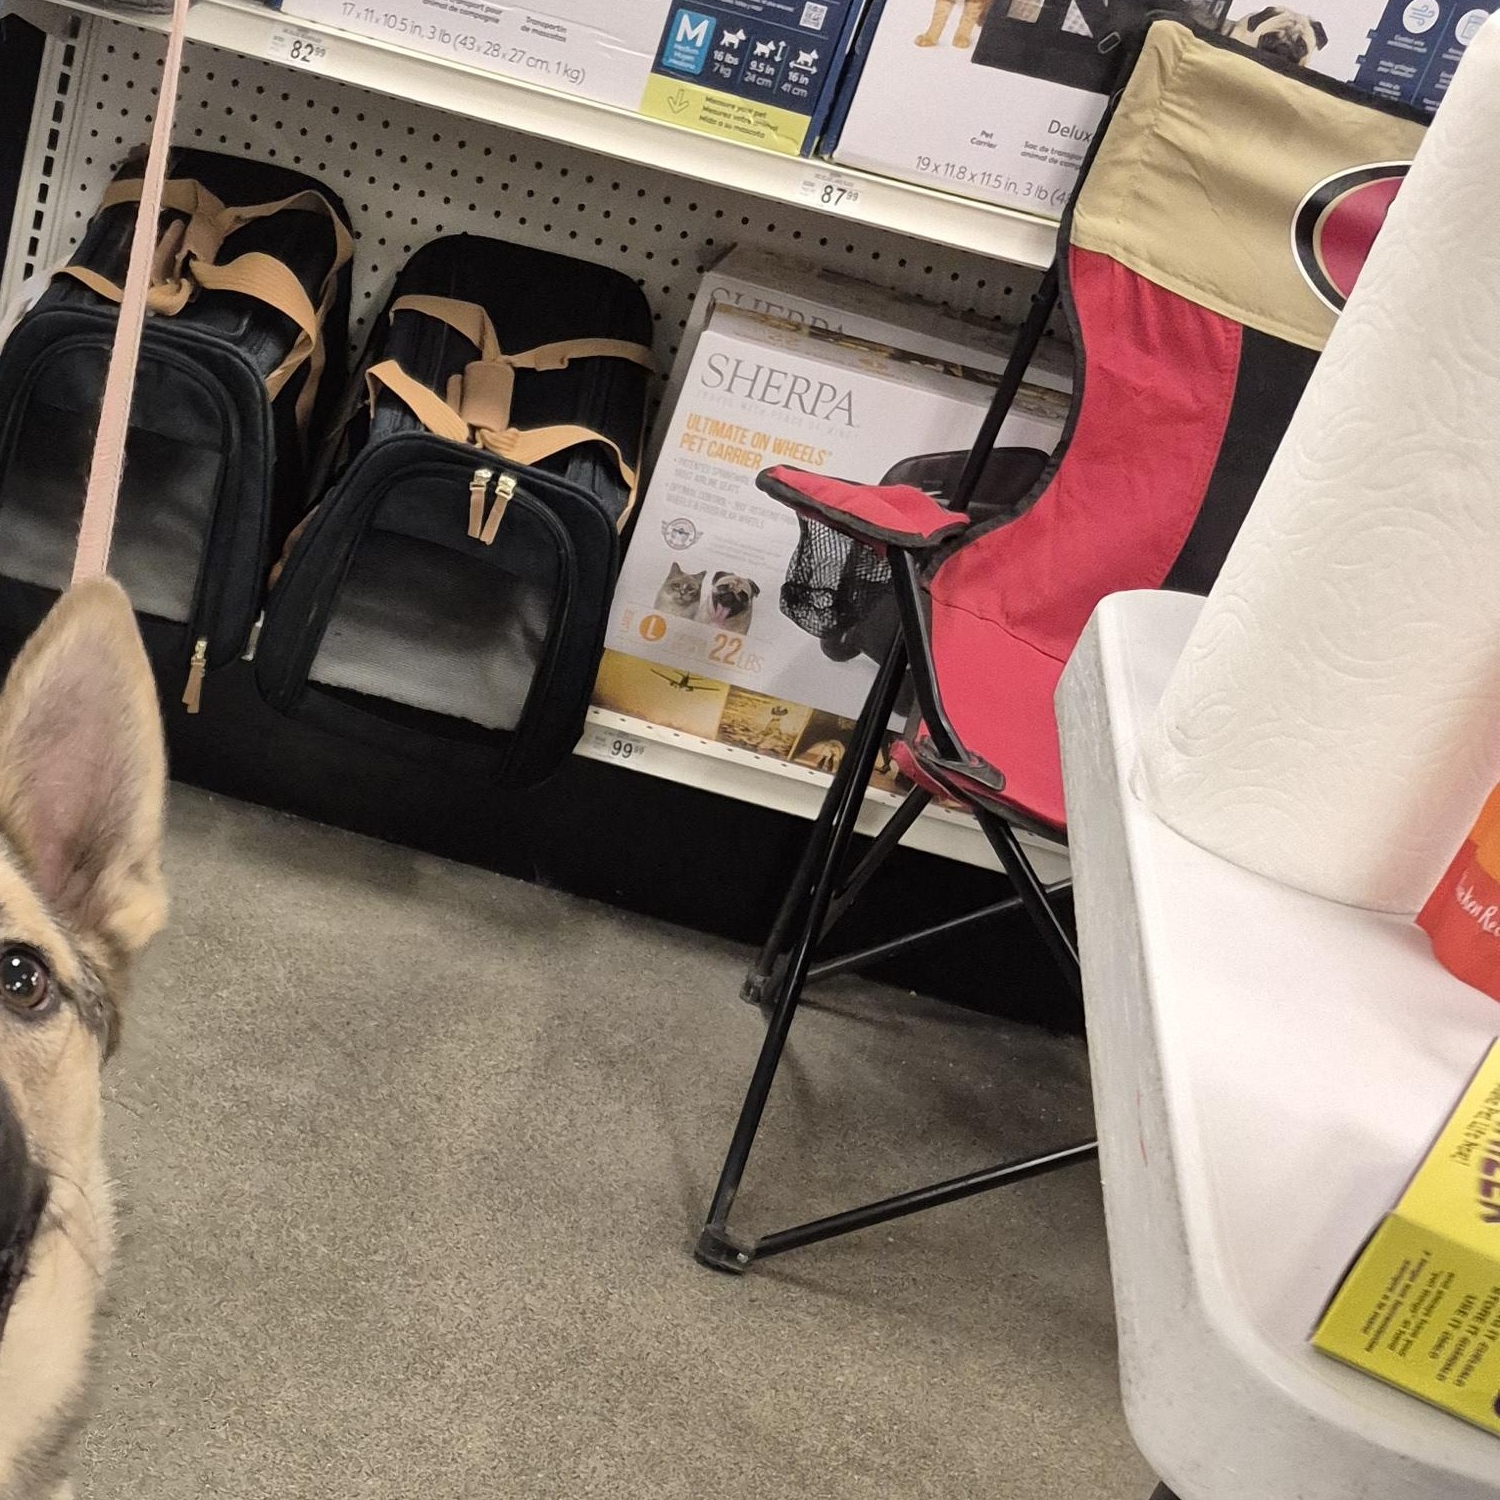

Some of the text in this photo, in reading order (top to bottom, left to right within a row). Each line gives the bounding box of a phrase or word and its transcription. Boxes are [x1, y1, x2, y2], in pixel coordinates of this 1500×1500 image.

[427, 25, 437, 40] 3
[676, 14, 709, 47] M
[765, 65, 775, 76] in
[756, 77, 772, 88] cm
[799, 75, 810, 86] in
[792, 86, 808, 98] cm
[1047, 119, 1094, 143] Delux
[1023, 182, 1033, 196] 3
[1034, 185, 1048, 201] lb
[701, 352, 857, 428] SHERPA
[686, 412, 747, 446] ULTIMATE
[752, 431, 770, 450] ON
[680, 433, 706, 454] PET
[706, 441, 763, 471] CARRIER
